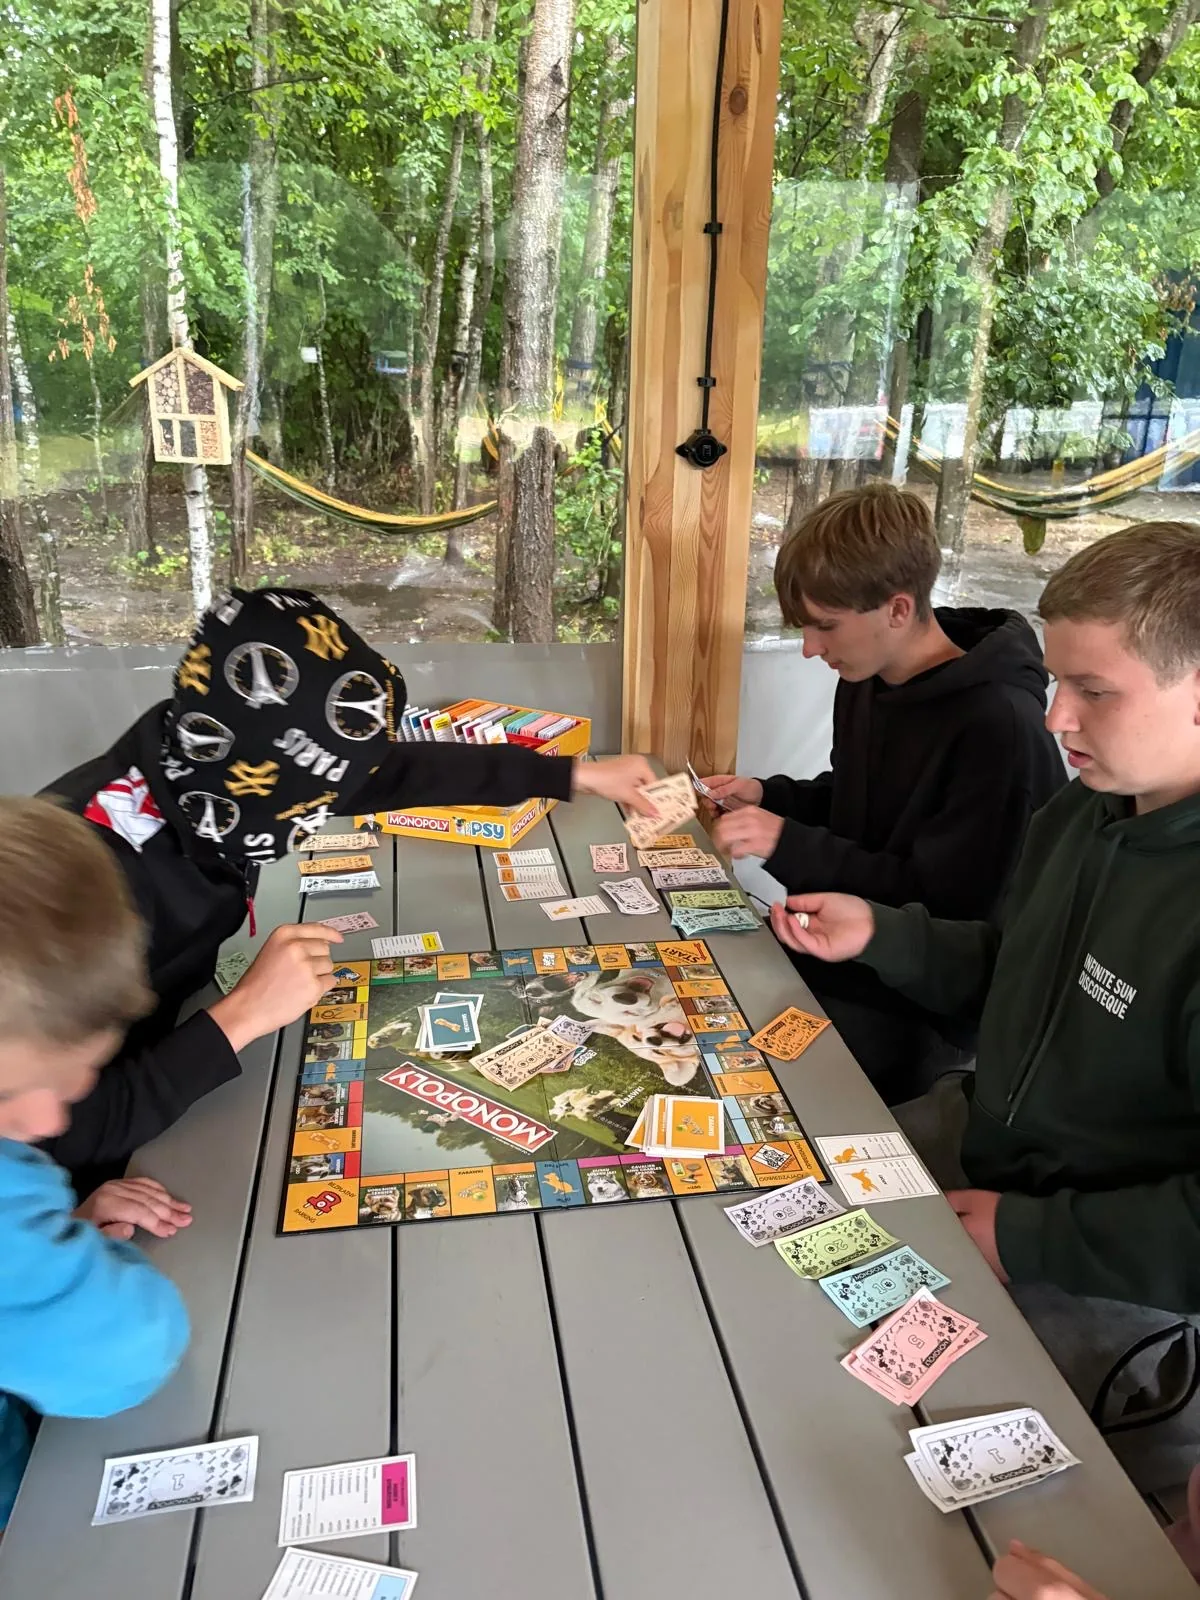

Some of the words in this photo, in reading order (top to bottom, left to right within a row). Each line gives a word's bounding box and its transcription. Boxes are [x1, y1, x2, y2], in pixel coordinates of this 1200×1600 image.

[272, 727, 350, 783] PARIS
[388, 814, 449, 831] MONOPOLY
[471, 821, 505, 840] PSY
[661, 947, 701, 963] START
[1083, 952, 1116, 990] INFINITE
[1113, 978, 1138, 1005] SUN
[1078, 969, 1128, 1020] DISCOTEQUE
[388, 1069, 548, 1145] MONOPOLY
[617, 1085, 645, 1108] ZABAWKI
[780, 1215, 814, 1233] MONOPOLY
[833, 1249, 868, 1267] MONOPOLY
[853, 1263, 887, 1282] MONOPOLY
[872, 1277, 897, 1295] 10
[908, 1334, 924, 1350] 5
[924, 1341, 950, 1367] MONOPOLY
[992, 1466, 1034, 1483] MONOPOLY
